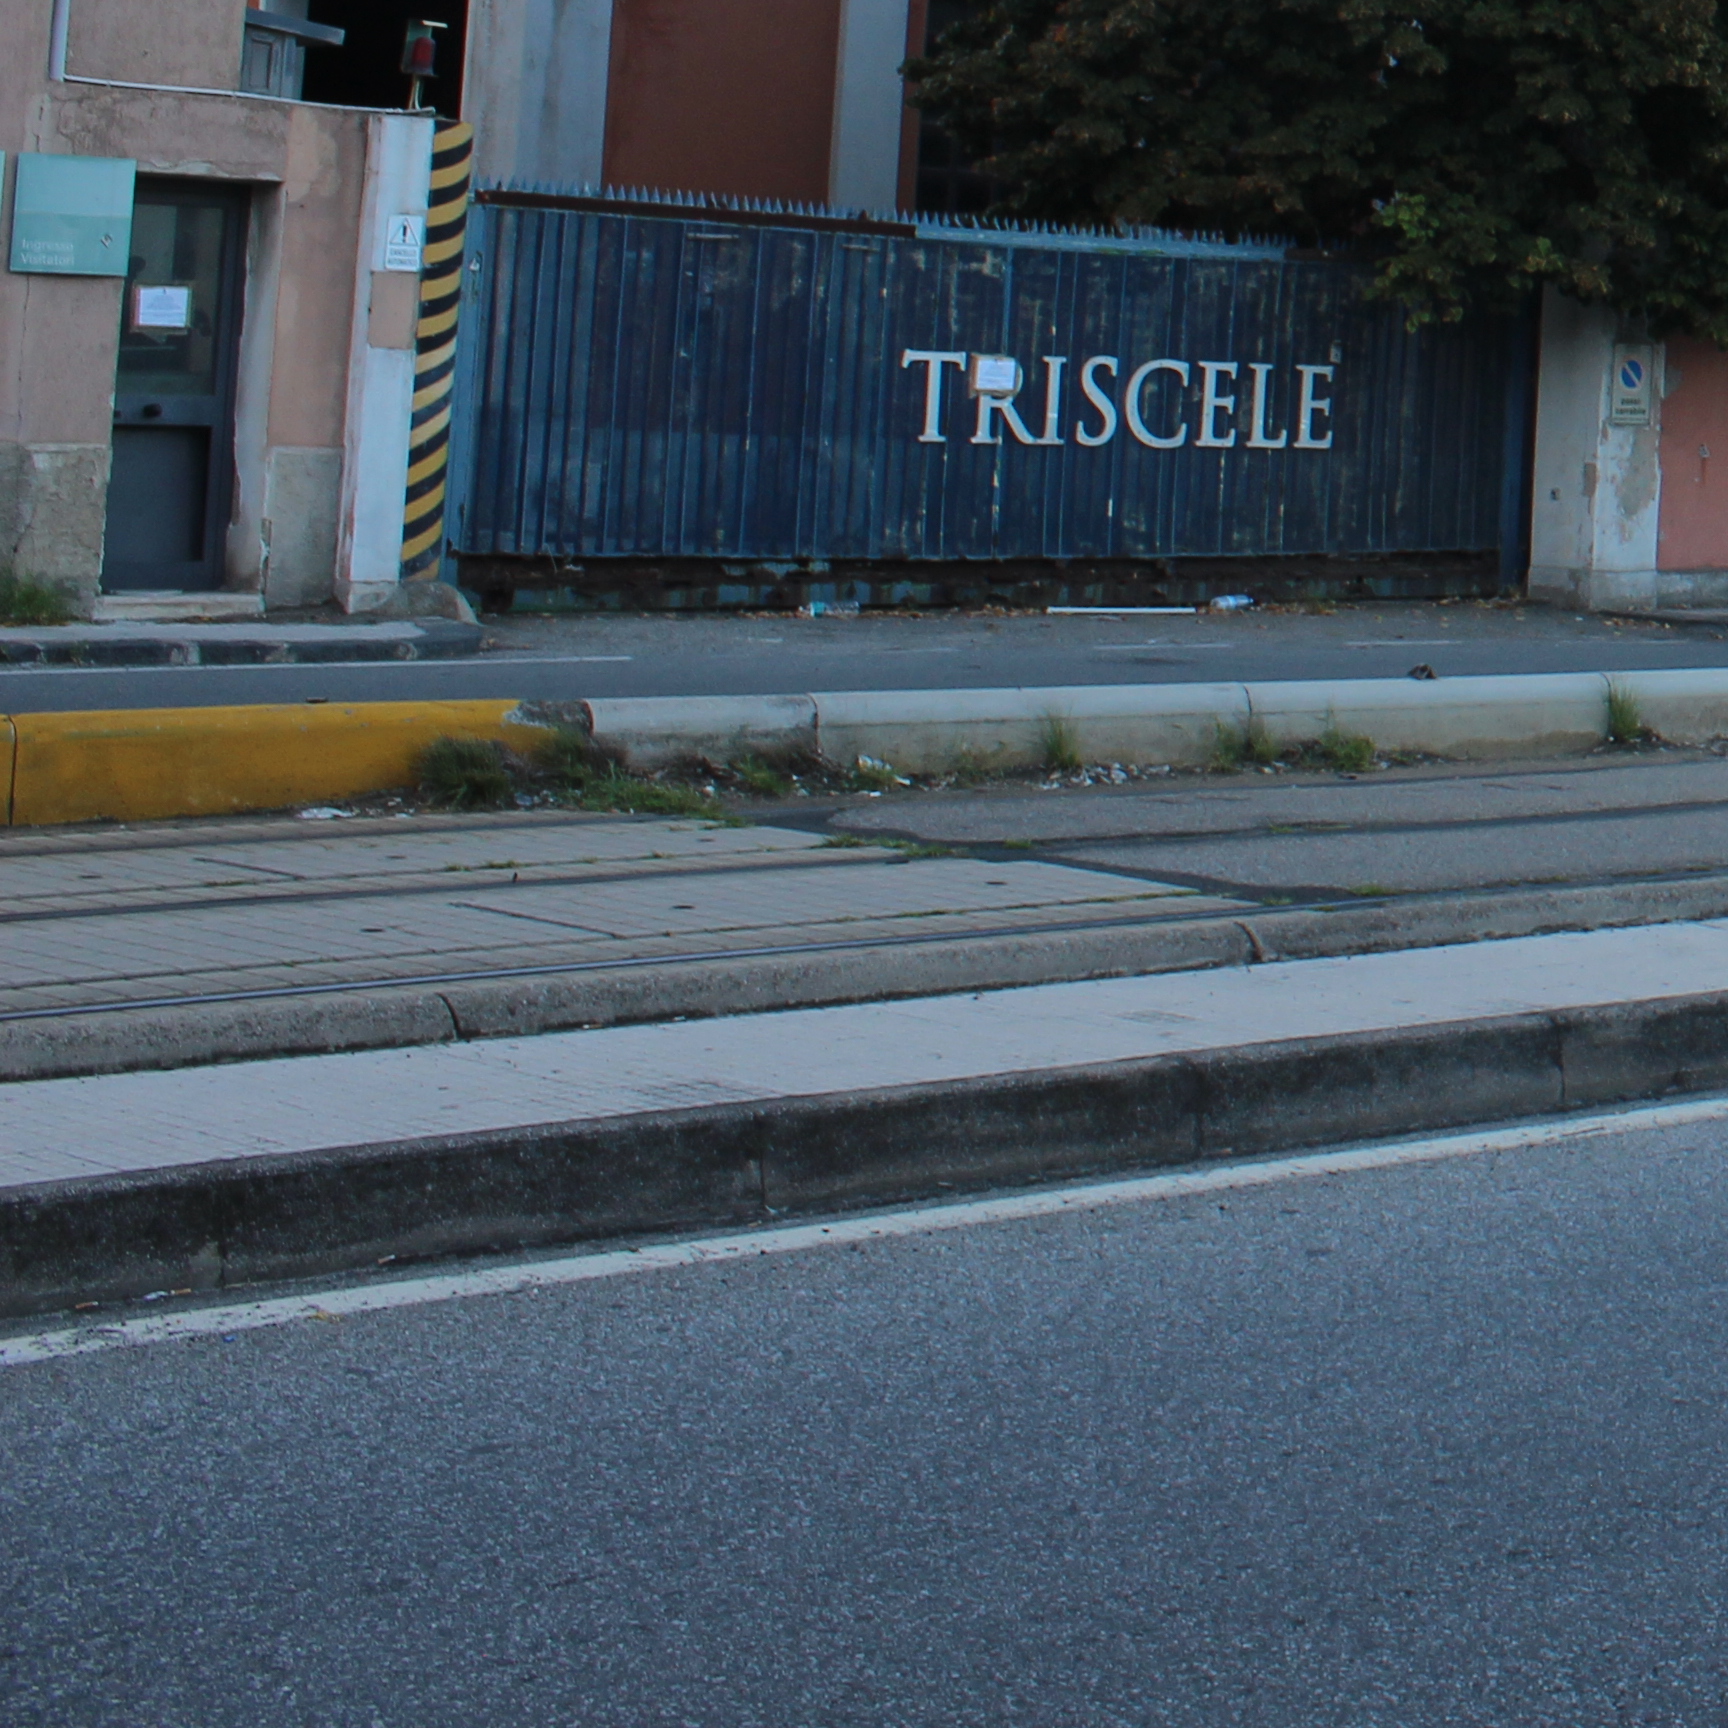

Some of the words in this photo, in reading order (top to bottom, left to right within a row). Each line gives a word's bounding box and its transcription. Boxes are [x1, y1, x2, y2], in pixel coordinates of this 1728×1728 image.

[21, 238, 74, 252] Ingresso
[20, 252, 75, 266] Visitatori
[902, 349, 1335, 449] TRISCELE
